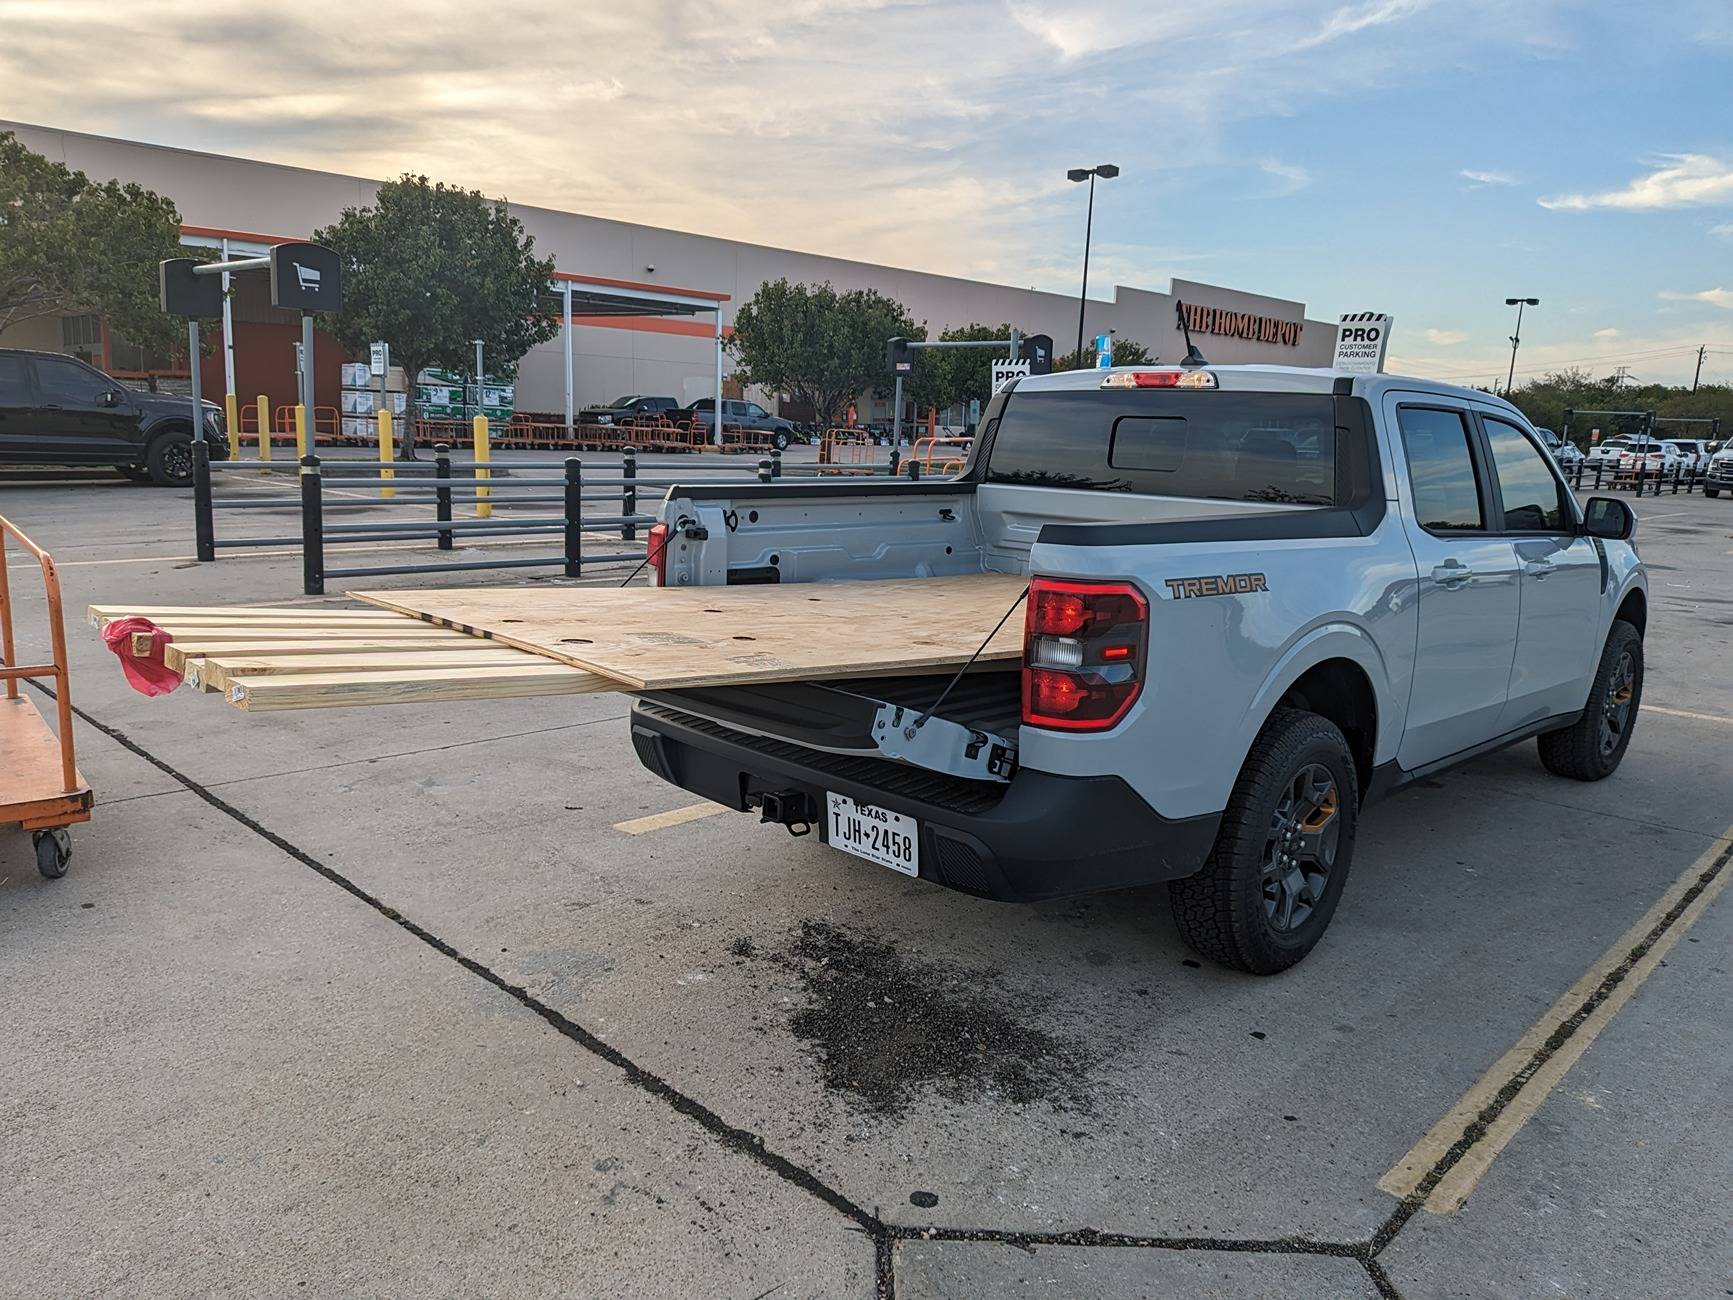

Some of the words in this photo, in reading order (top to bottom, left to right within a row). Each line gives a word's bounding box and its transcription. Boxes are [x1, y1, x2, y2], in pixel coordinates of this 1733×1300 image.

[1212, 308, 1258, 340] HOME
[1258, 316, 1303, 346] DEPOT
[1341, 327, 1380, 342] PRO
[1338, 350, 1376, 358] PARKING
[1165, 572, 1269, 600] TREMOR
[854, 804, 888, 823] TEXAS
